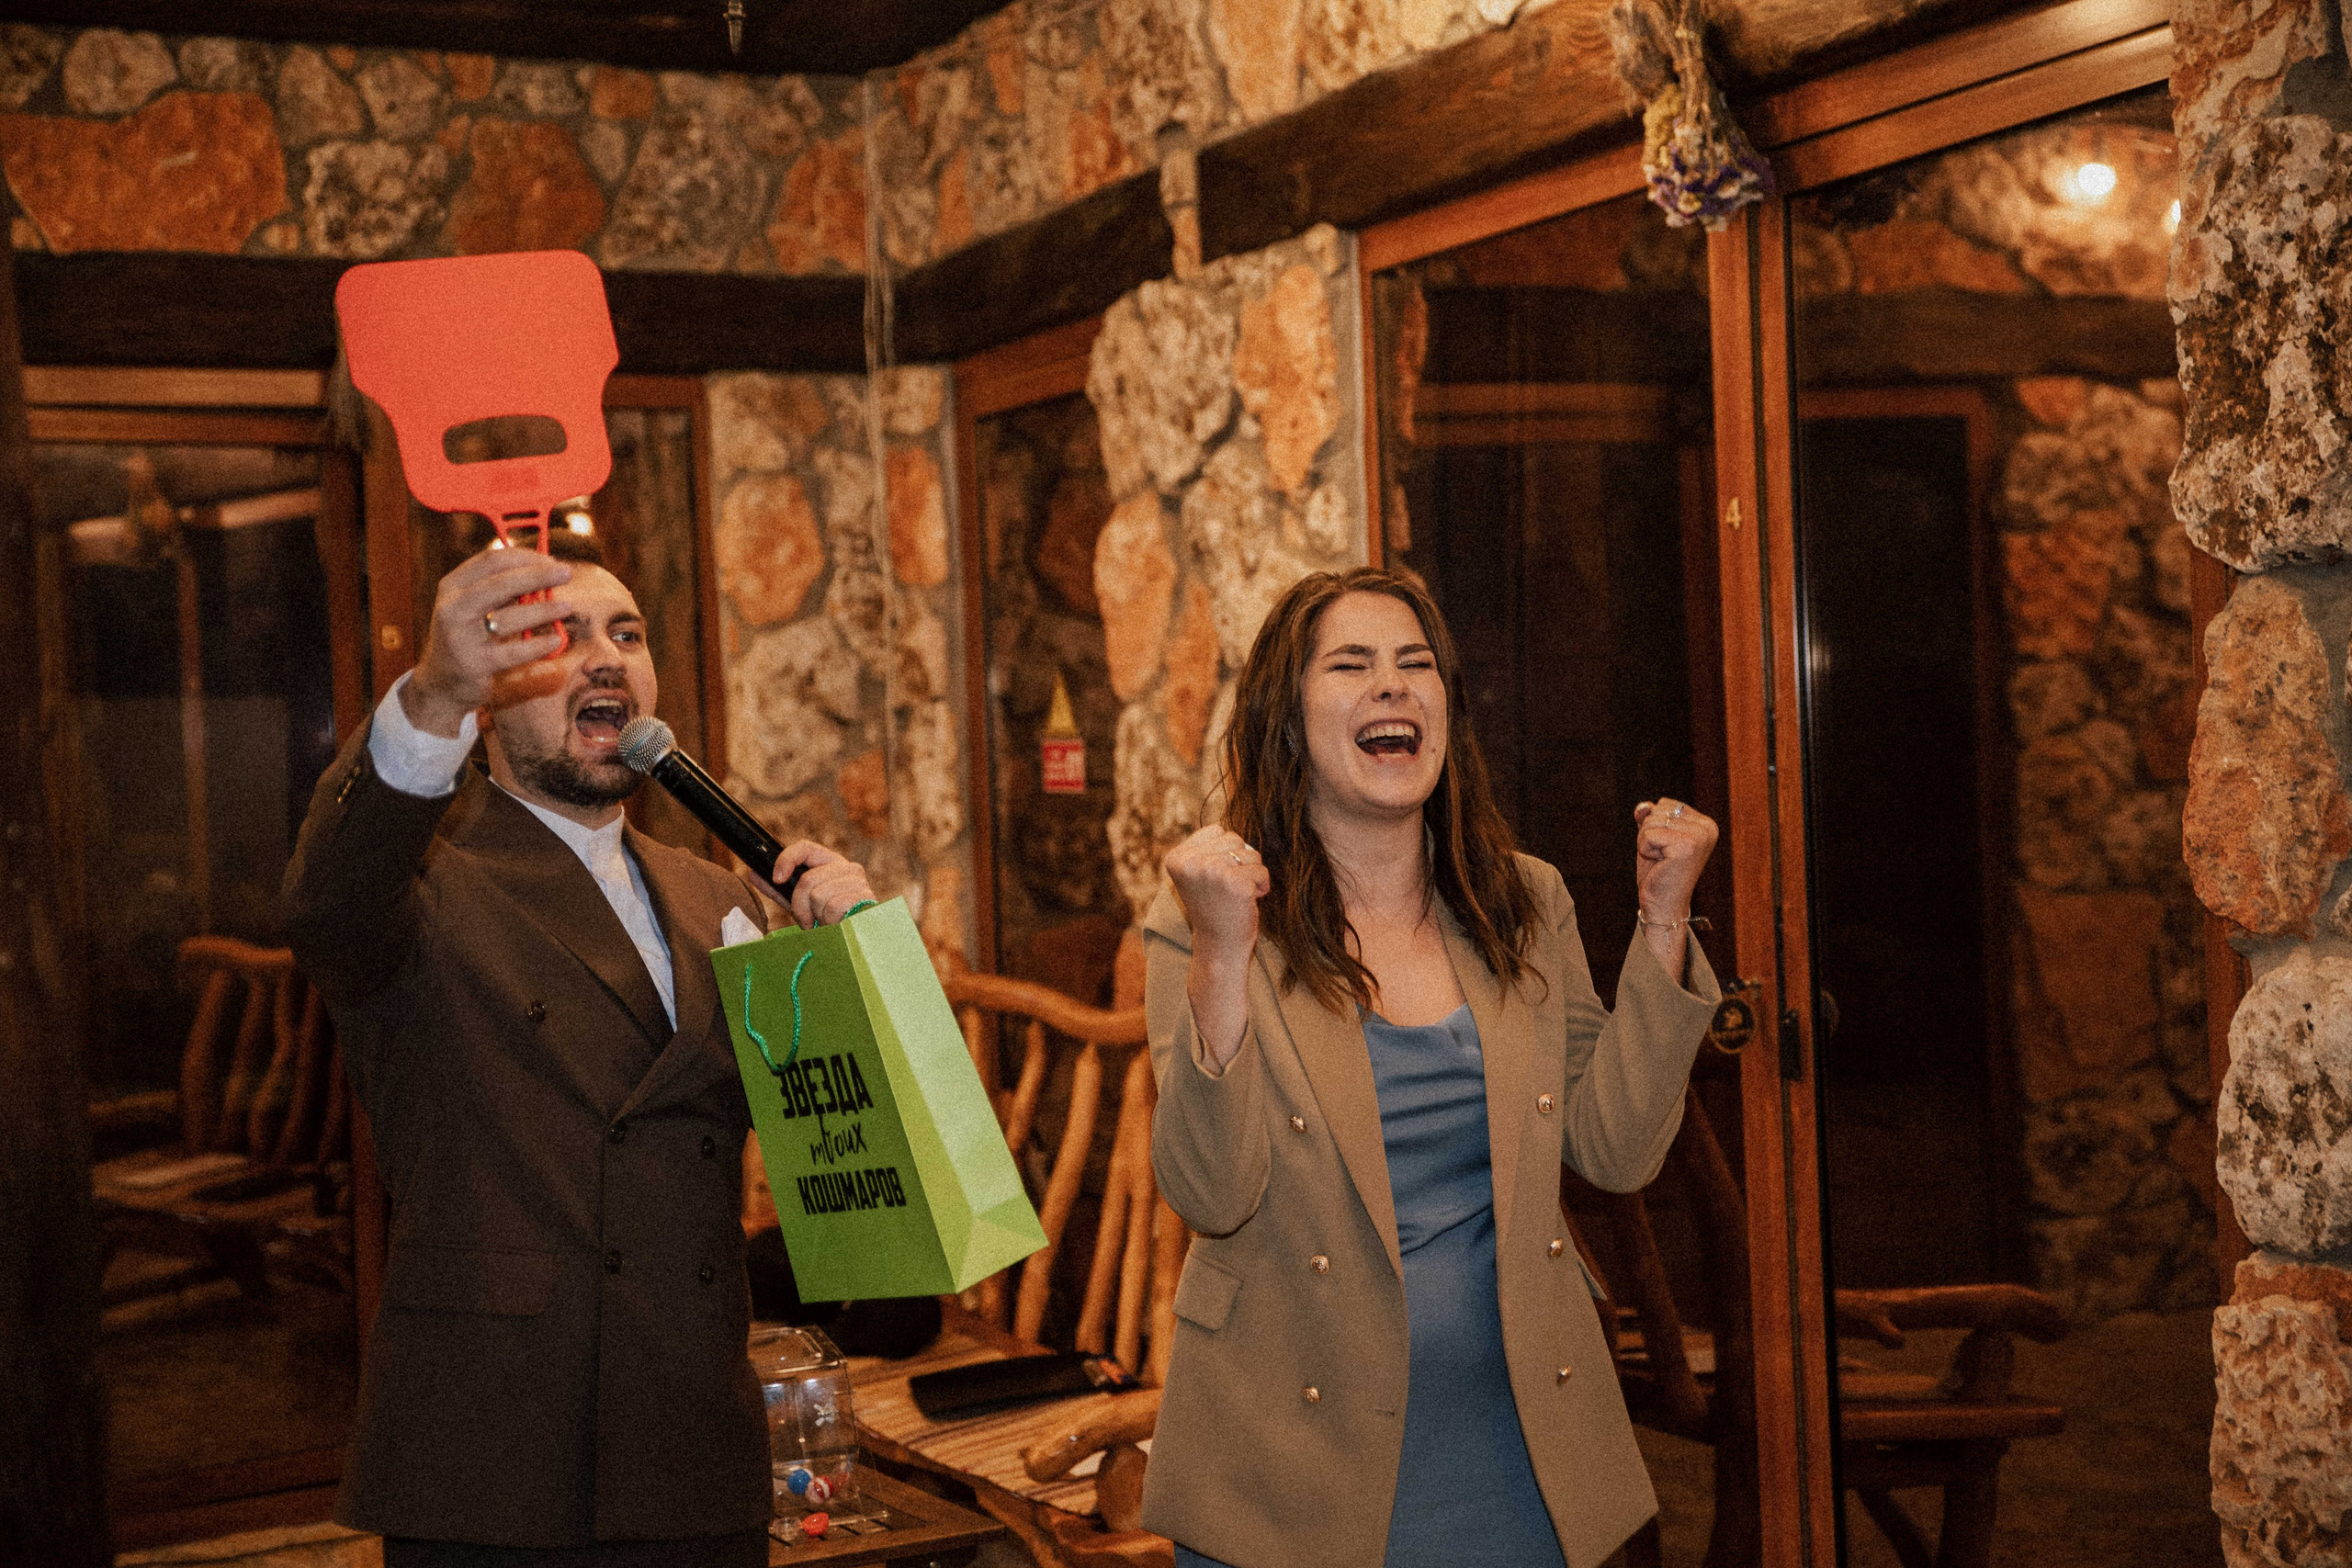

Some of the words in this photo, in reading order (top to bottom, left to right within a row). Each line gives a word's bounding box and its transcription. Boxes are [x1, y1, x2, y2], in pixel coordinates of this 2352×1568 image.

[774, 1053, 874, 1119] ЗВЕЗДА
[810, 1115, 867, 1166] твоих
[797, 1168, 907, 1215] КОШМАРОВ
